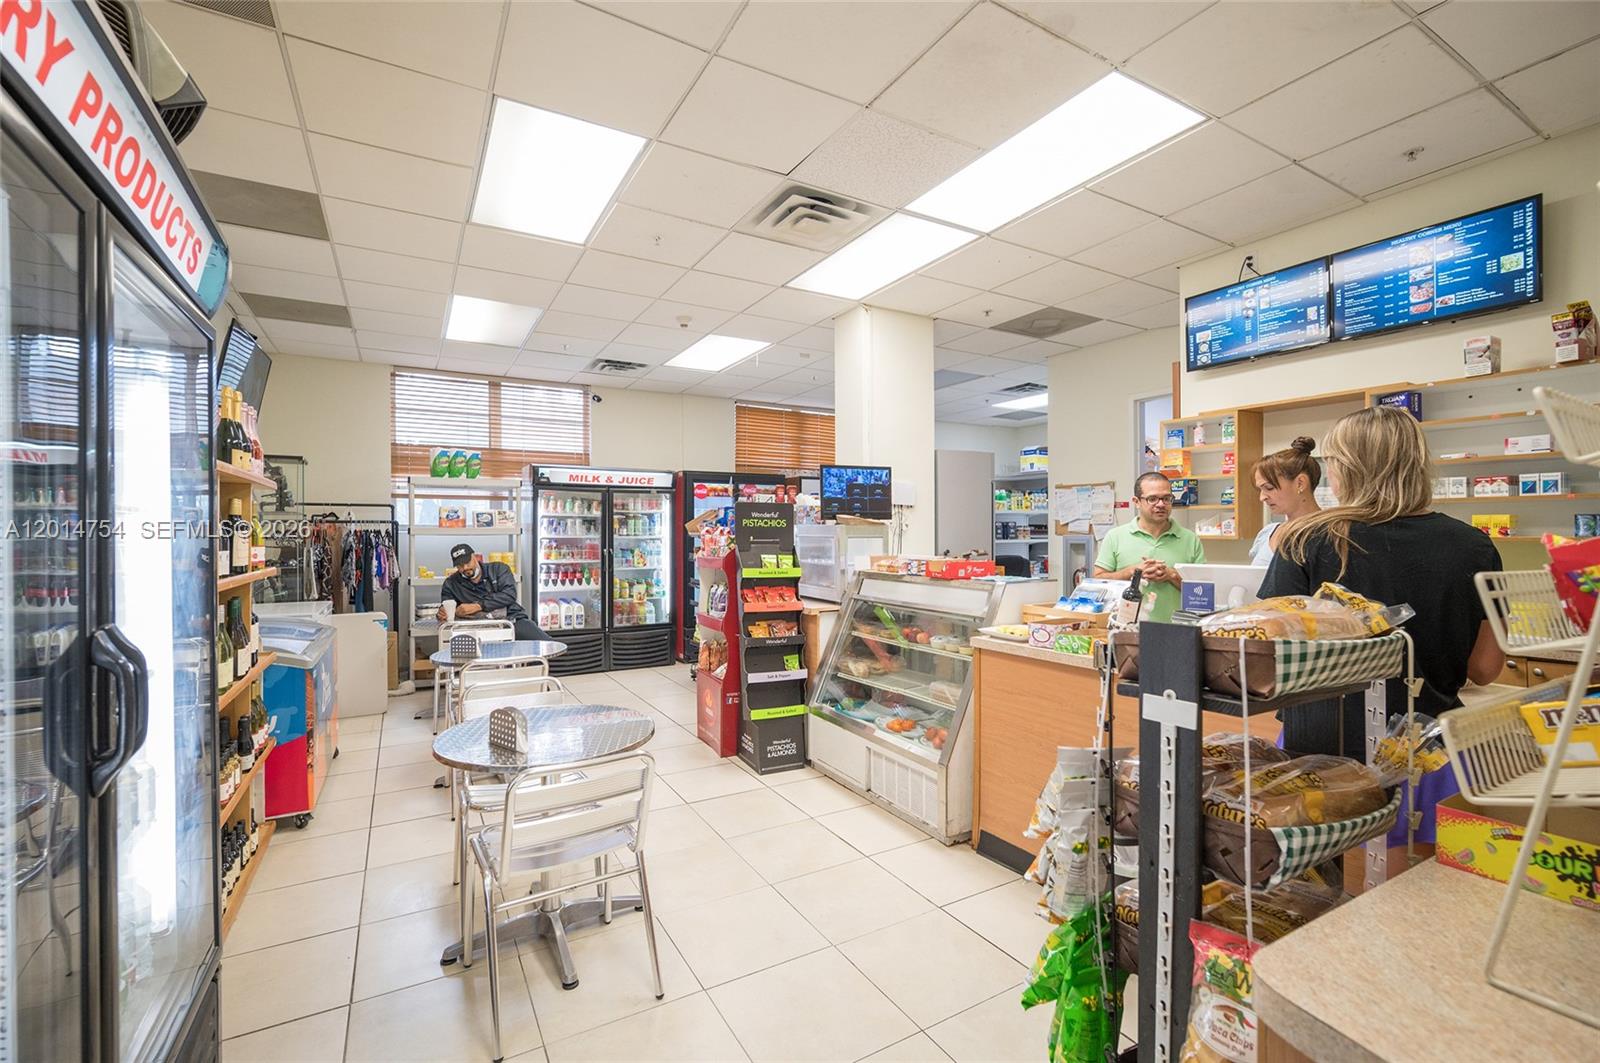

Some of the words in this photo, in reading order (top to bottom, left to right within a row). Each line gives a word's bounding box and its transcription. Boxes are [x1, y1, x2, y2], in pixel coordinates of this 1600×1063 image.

[68, 70, 203, 275] PRODUCTS
[1443, 220, 1463, 231] MENU
[568, 473, 601, 484] MILK
[605, 475, 615, 484] &
[618, 476, 655, 486] JUICE
[742, 519, 787, 528] PISTACHIOS
[767, 743, 797, 753] PISTACHIOS
[1528, 850, 1593, 882] OUR
